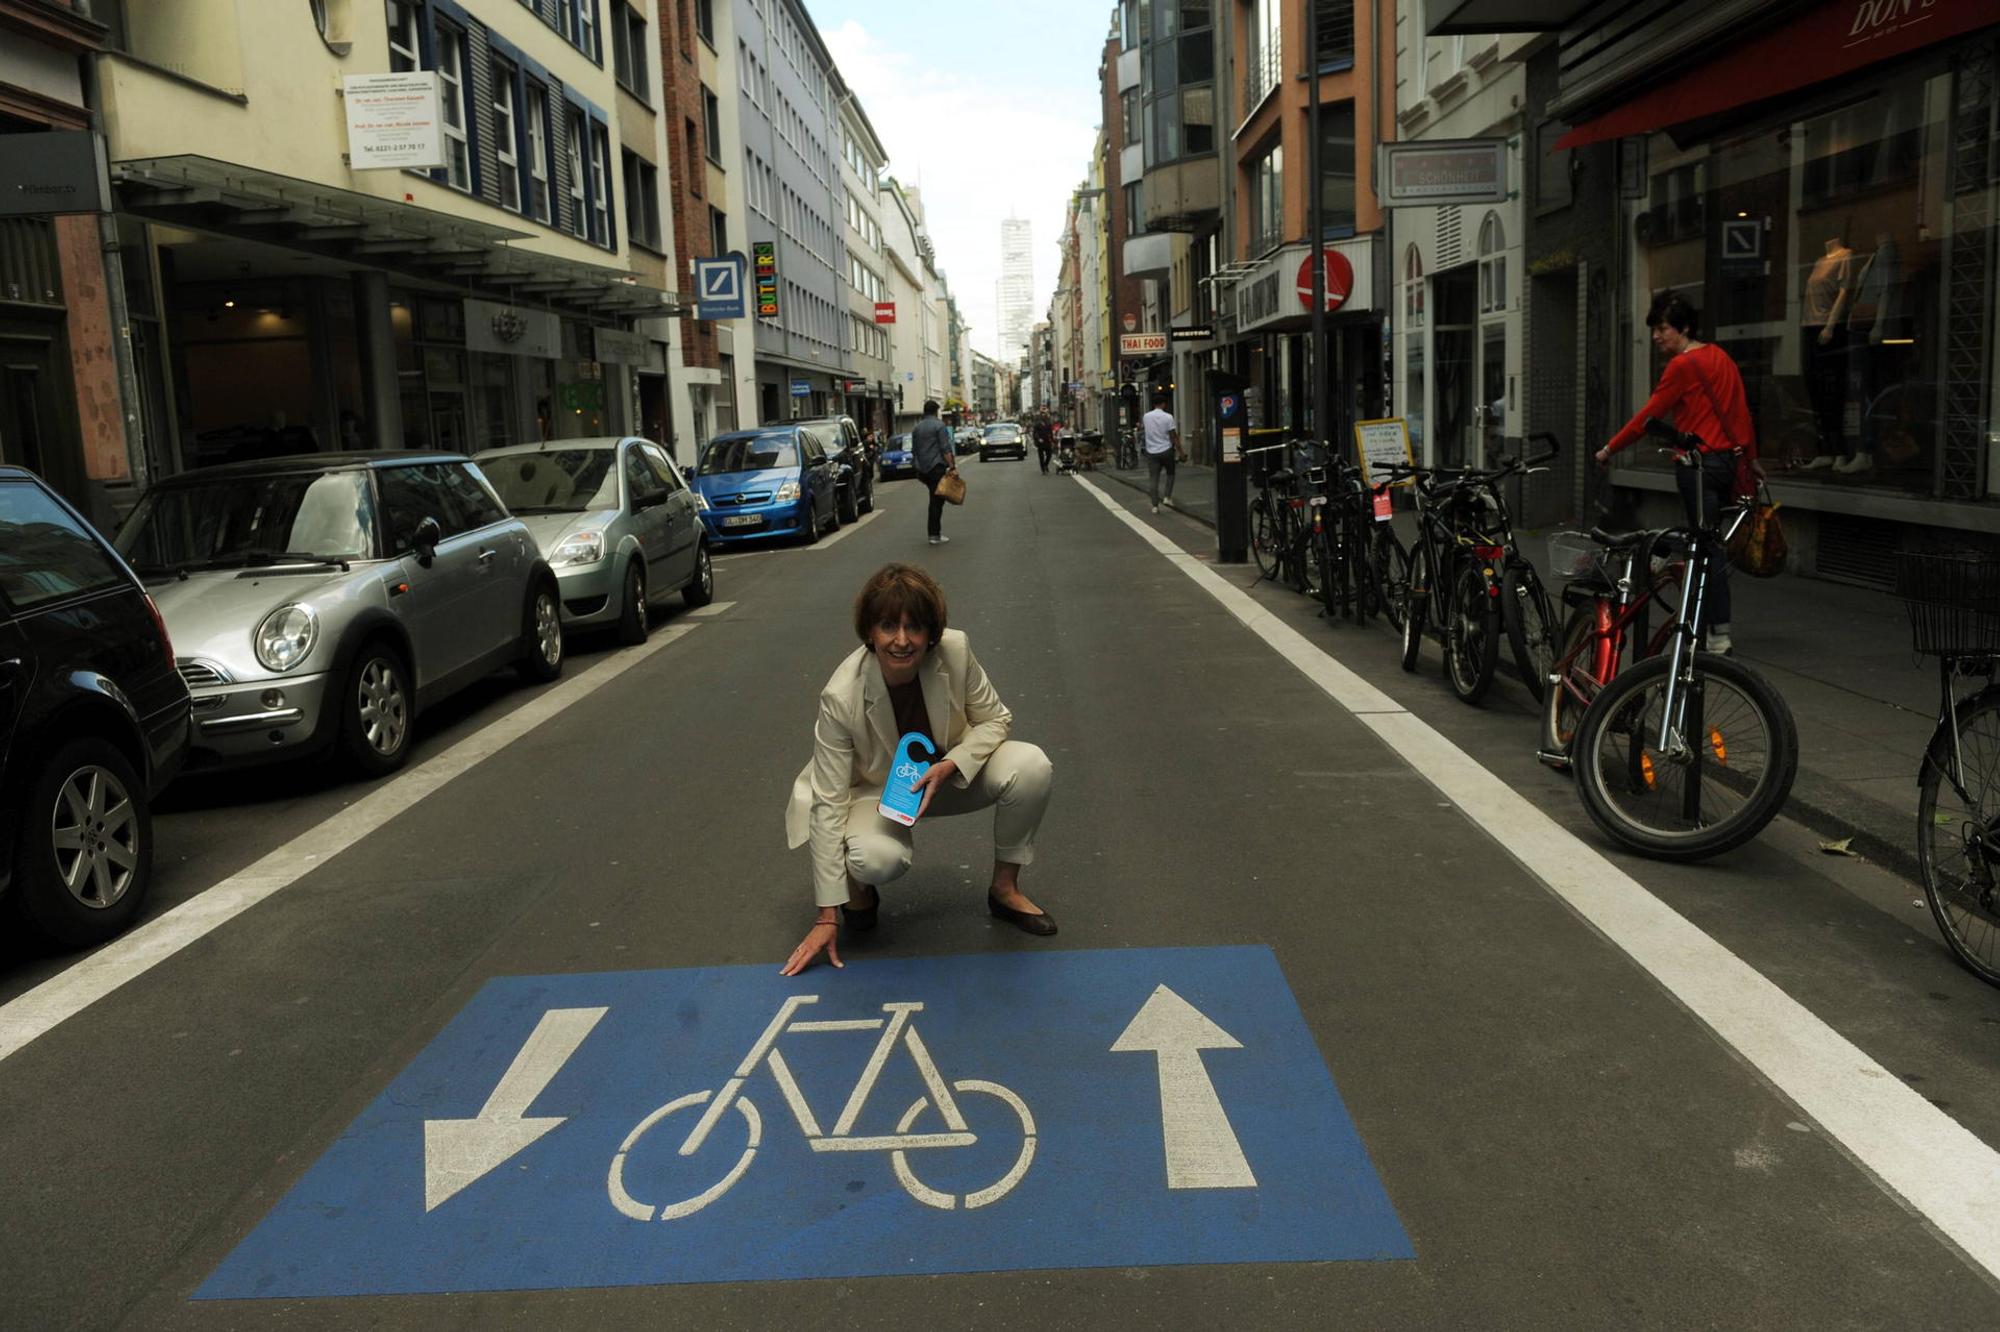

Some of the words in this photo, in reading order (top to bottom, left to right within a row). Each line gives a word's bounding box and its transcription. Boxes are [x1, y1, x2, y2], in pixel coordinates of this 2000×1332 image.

[757, 244, 777, 313] BUTLERS
[1122, 339, 1141, 349] THAI
[1144, 338, 1165, 348] FOOD
